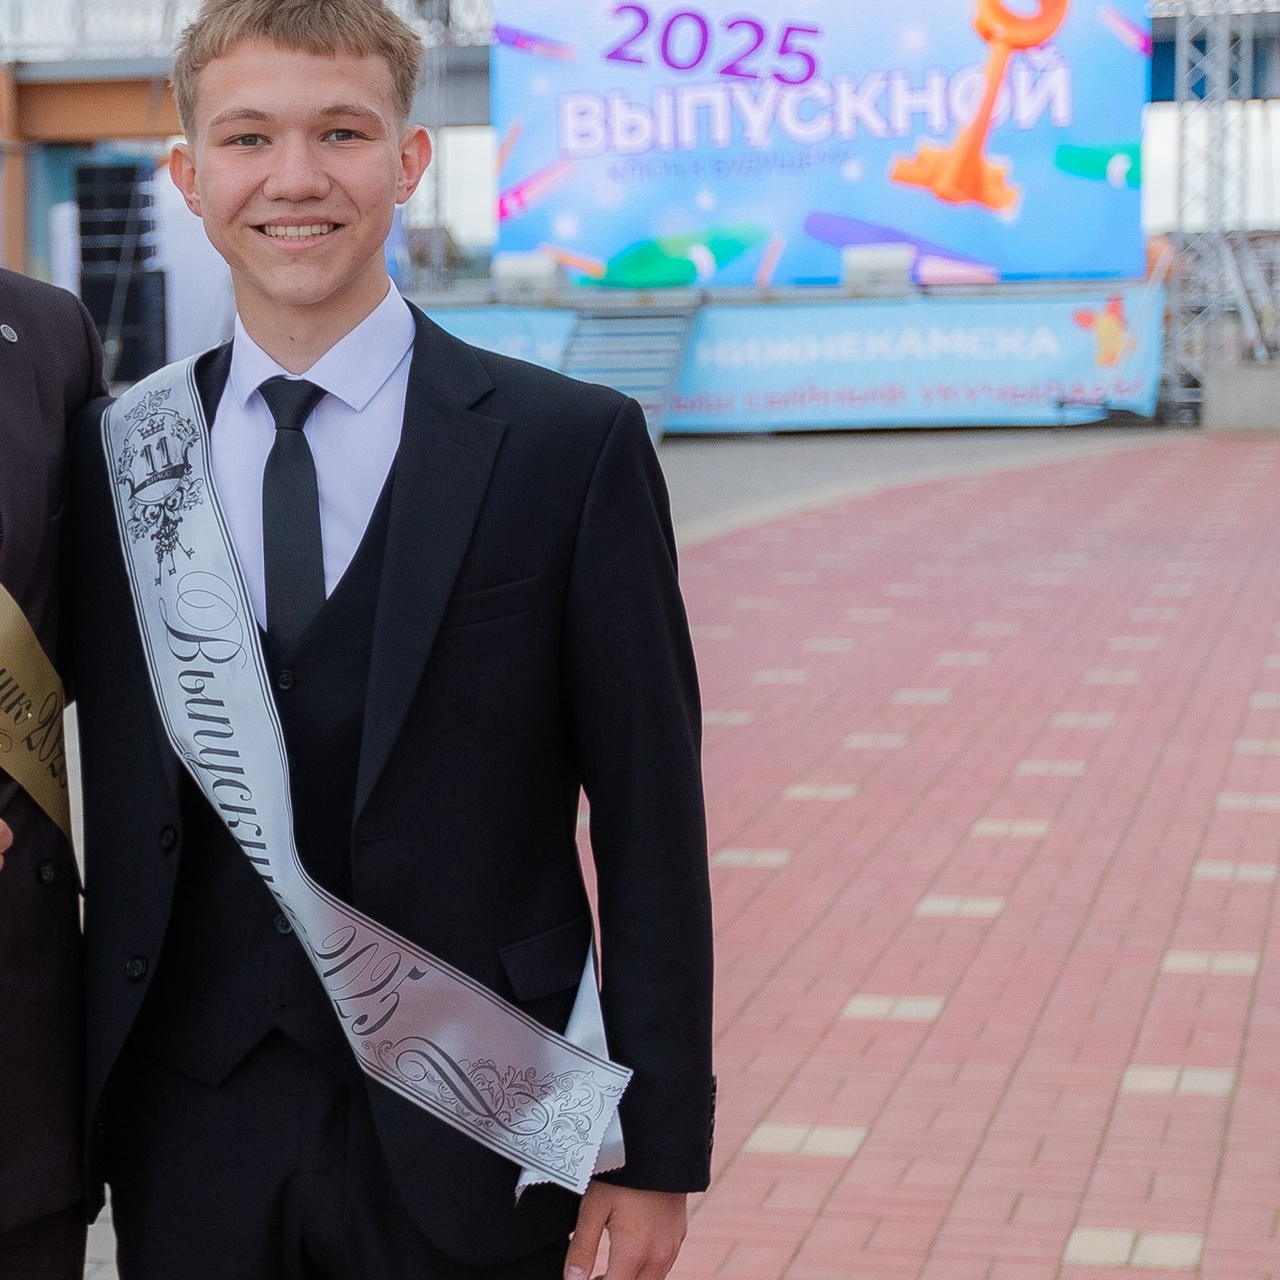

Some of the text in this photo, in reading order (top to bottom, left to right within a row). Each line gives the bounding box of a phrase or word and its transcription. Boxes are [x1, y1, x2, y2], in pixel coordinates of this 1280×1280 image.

[605, 2, 821, 85] 2025
[562, 46, 1073, 154] ВЫПУСКНОЙ
[140, 436, 173, 477] 11
[310, 925, 428, 1036] 2025
